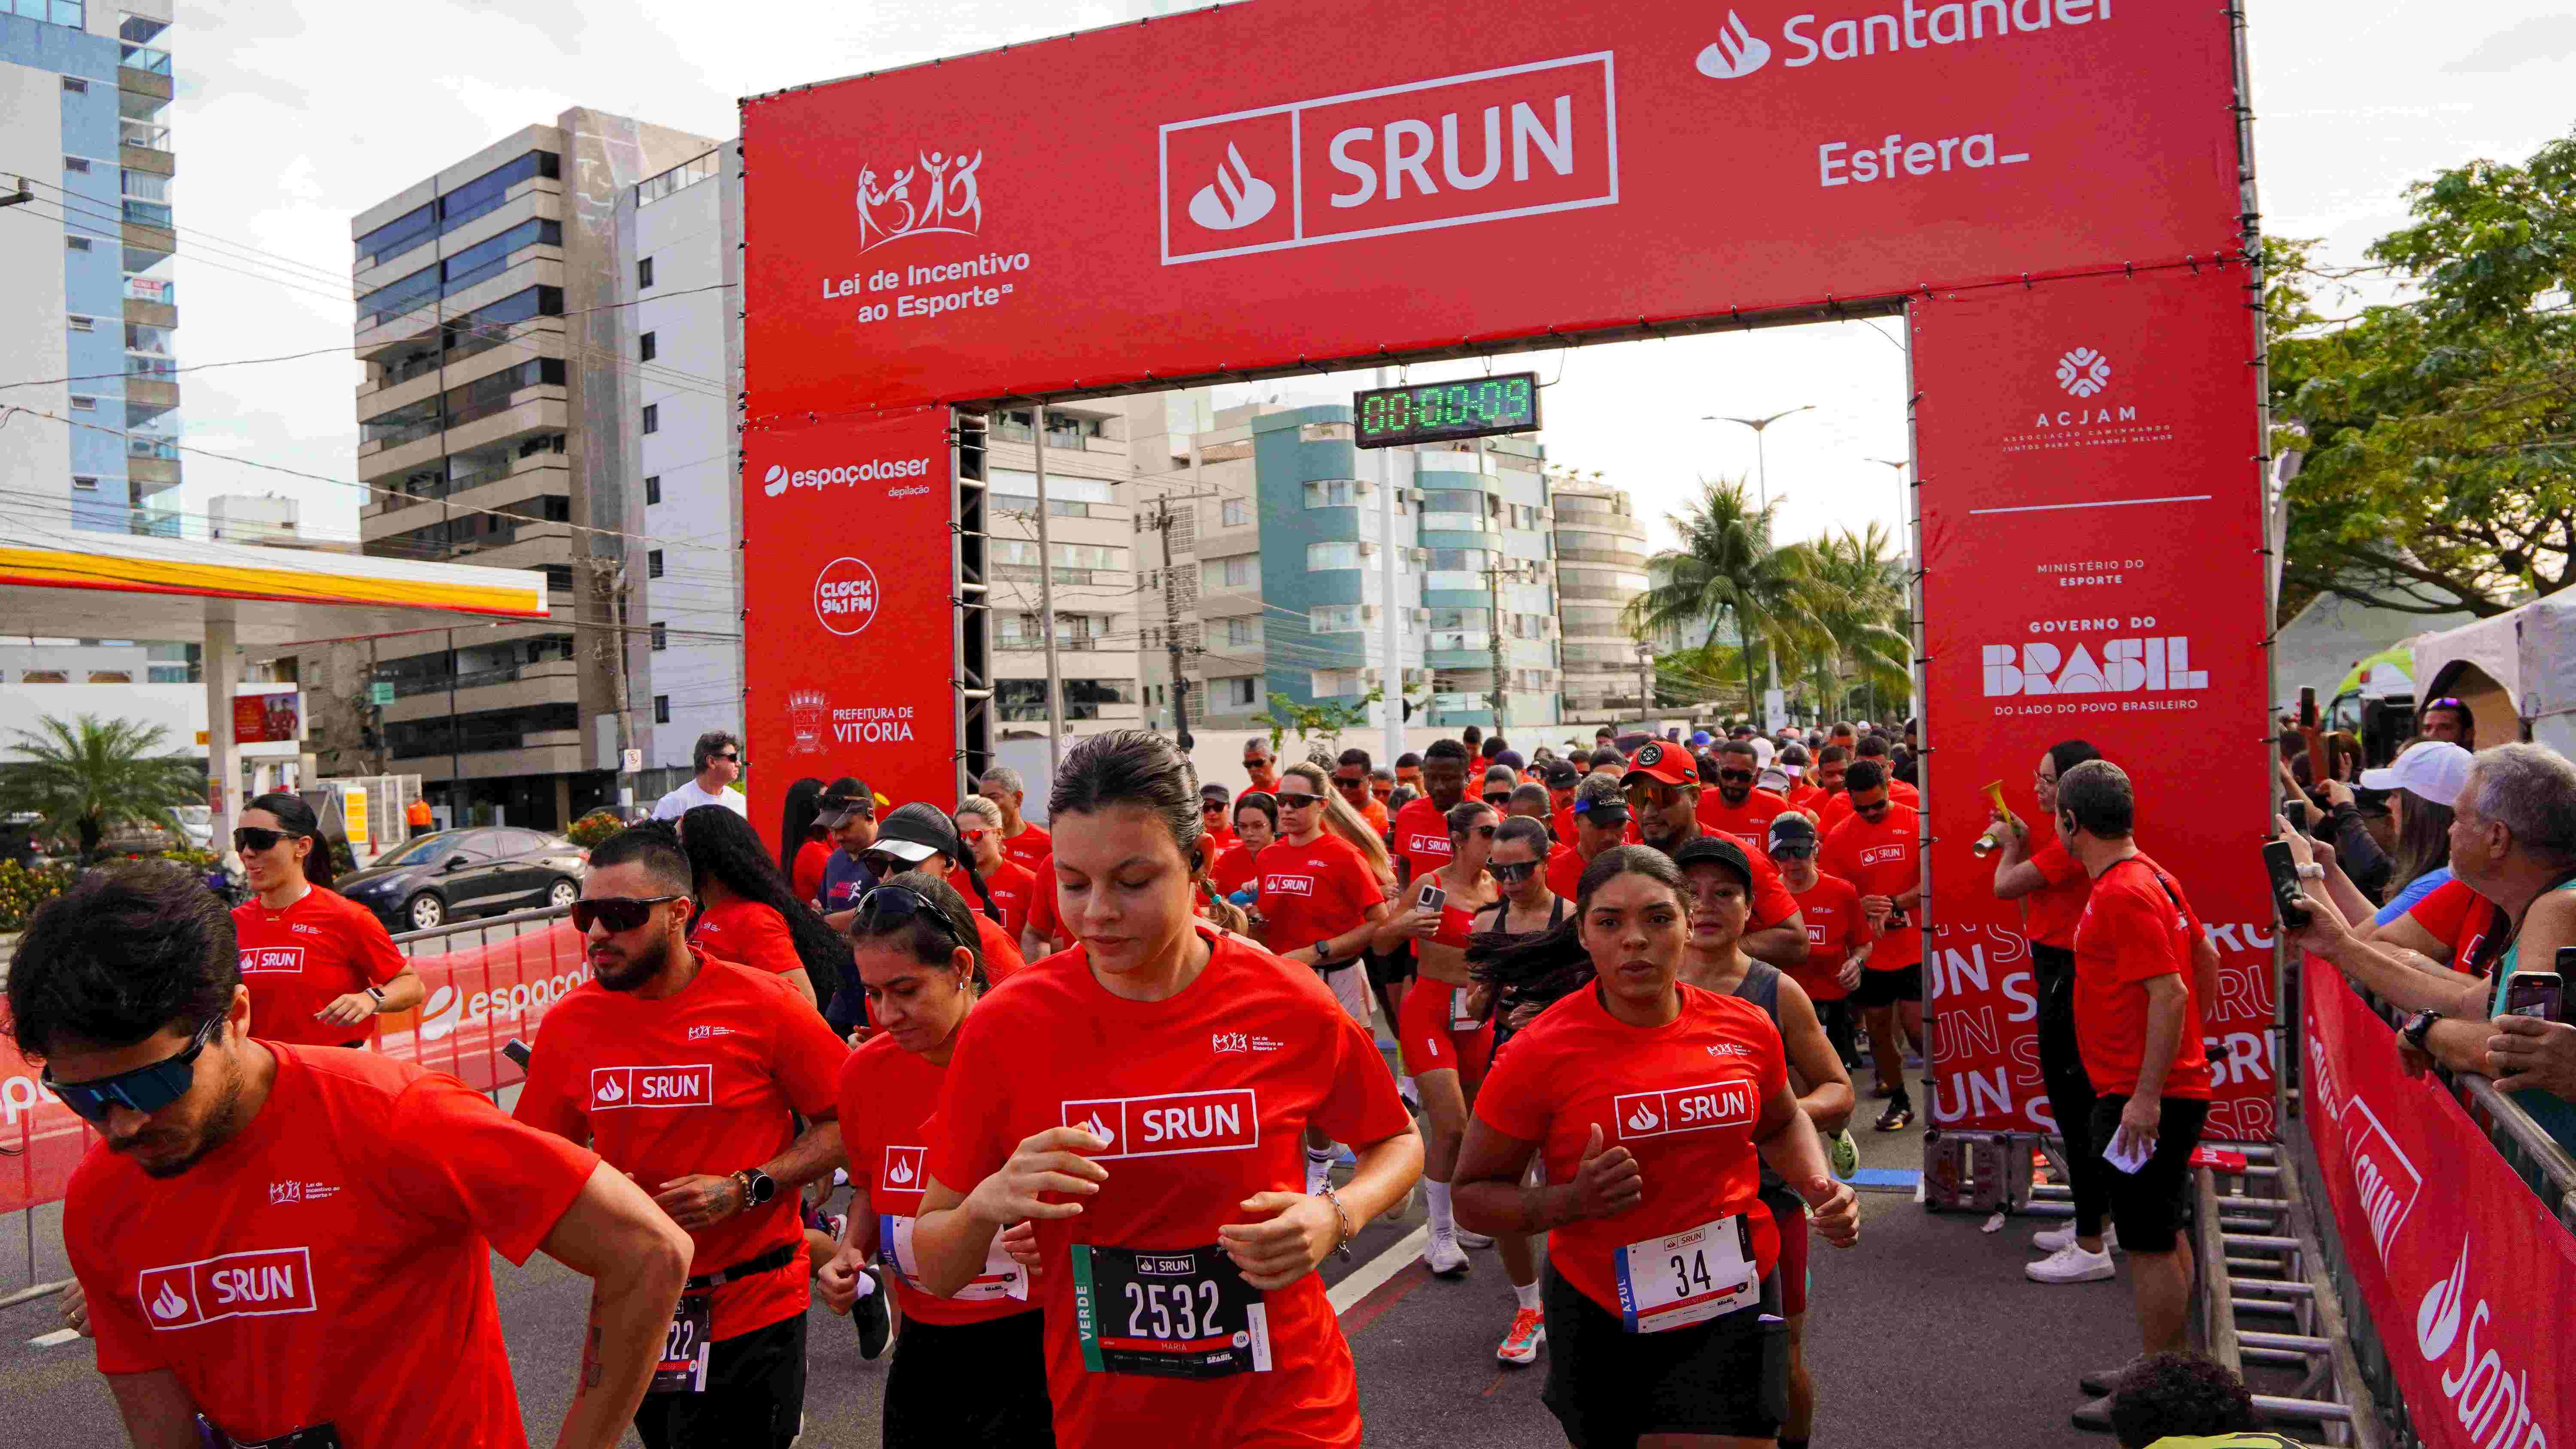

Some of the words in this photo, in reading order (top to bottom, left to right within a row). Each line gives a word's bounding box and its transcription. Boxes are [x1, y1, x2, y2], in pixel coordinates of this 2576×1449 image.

[1329, 95, 1573, 208] SRUN
[823, 273, 860, 299] Lei
[869, 269, 898, 292] de
[908, 252, 1029, 286] Incentivo
[859, 302, 887, 323] ao
[898, 284, 999, 318] Esporte
[1363, 378, 1528, 433] 00:00:09
[792, 458, 930, 491] espaçolaser
[889, 485, 929, 498] depilação
[2037, 560, 2119, 573] MINISTÉRIO
[2125, 559, 2144, 570] DO
[820, 580, 871, 597] CLOCK
[2060, 575, 2123, 587] ESPORTE
[851, 597, 871, 612] FM
[2029, 618, 2119, 633] GOVERNO
[2131, 616, 2156, 628] DO
[1982, 636, 2208, 697] BRASIL
[833, 708, 895, 720] PREFEITURA
[898, 707, 913, 718] DE
[1995, 705, 2013, 715] DO
[2018, 703, 2052, 715] LADO
[2057, 703, 2076, 714] DO
[2081, 702, 2117, 713] POVO
[2123, 699, 2198, 712] BRASILEIRO
[833, 718, 914, 743] VITÓRIA
[1428, 840, 1450, 852] SRUN
[1879, 848, 1900, 858] SRUN
[1281, 879, 1307, 891] SRUN
[261, 952, 295, 967] SRUN
[642, 1075, 699, 1098] SRUN
[1679, 1091, 1745, 1122] SRUN
[1143, 1103, 1240, 1142] SRUN
[1681, 1232, 1701, 1244] SRUN
[1159, 1260, 1189, 1271] SRUN
[1671, 1250, 1711, 1297] 34
[212, 1264, 294, 1303] SRUN
[1618, 1279, 1632, 1312] AZUL
[1075, 1284, 1093, 1341] VERDE
[1125, 1279, 1223, 1339] 2532
[1161, 1342, 1187, 1351] MARIA
